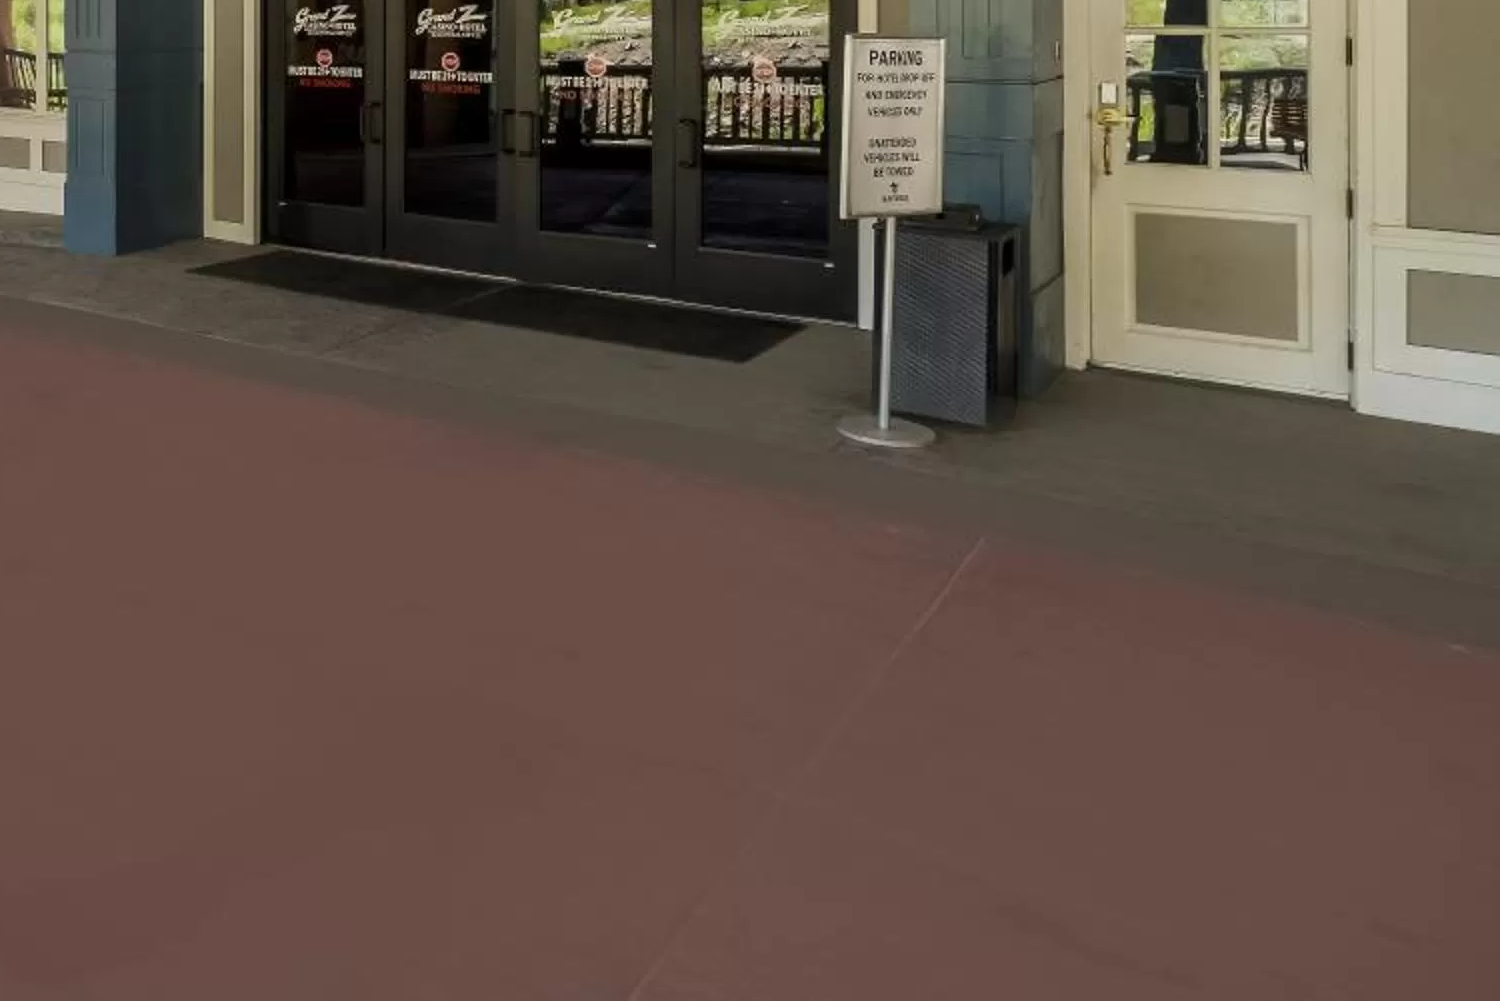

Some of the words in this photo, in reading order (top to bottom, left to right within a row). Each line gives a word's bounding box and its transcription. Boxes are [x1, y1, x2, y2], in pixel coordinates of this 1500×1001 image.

[293, 7, 331, 33] Grand
[330, 4, 357, 22] Z
[415, 8, 457, 34] Grand
[455, 4, 488, 23] Z
[869, 50, 923, 66] PARKING
[546, 76, 573, 87] MUST
[573, 77, 585, 88] BE
[857, 72, 874, 84] FOR
[866, 90, 882, 100] AND
[873, 167, 884, 178] BE
